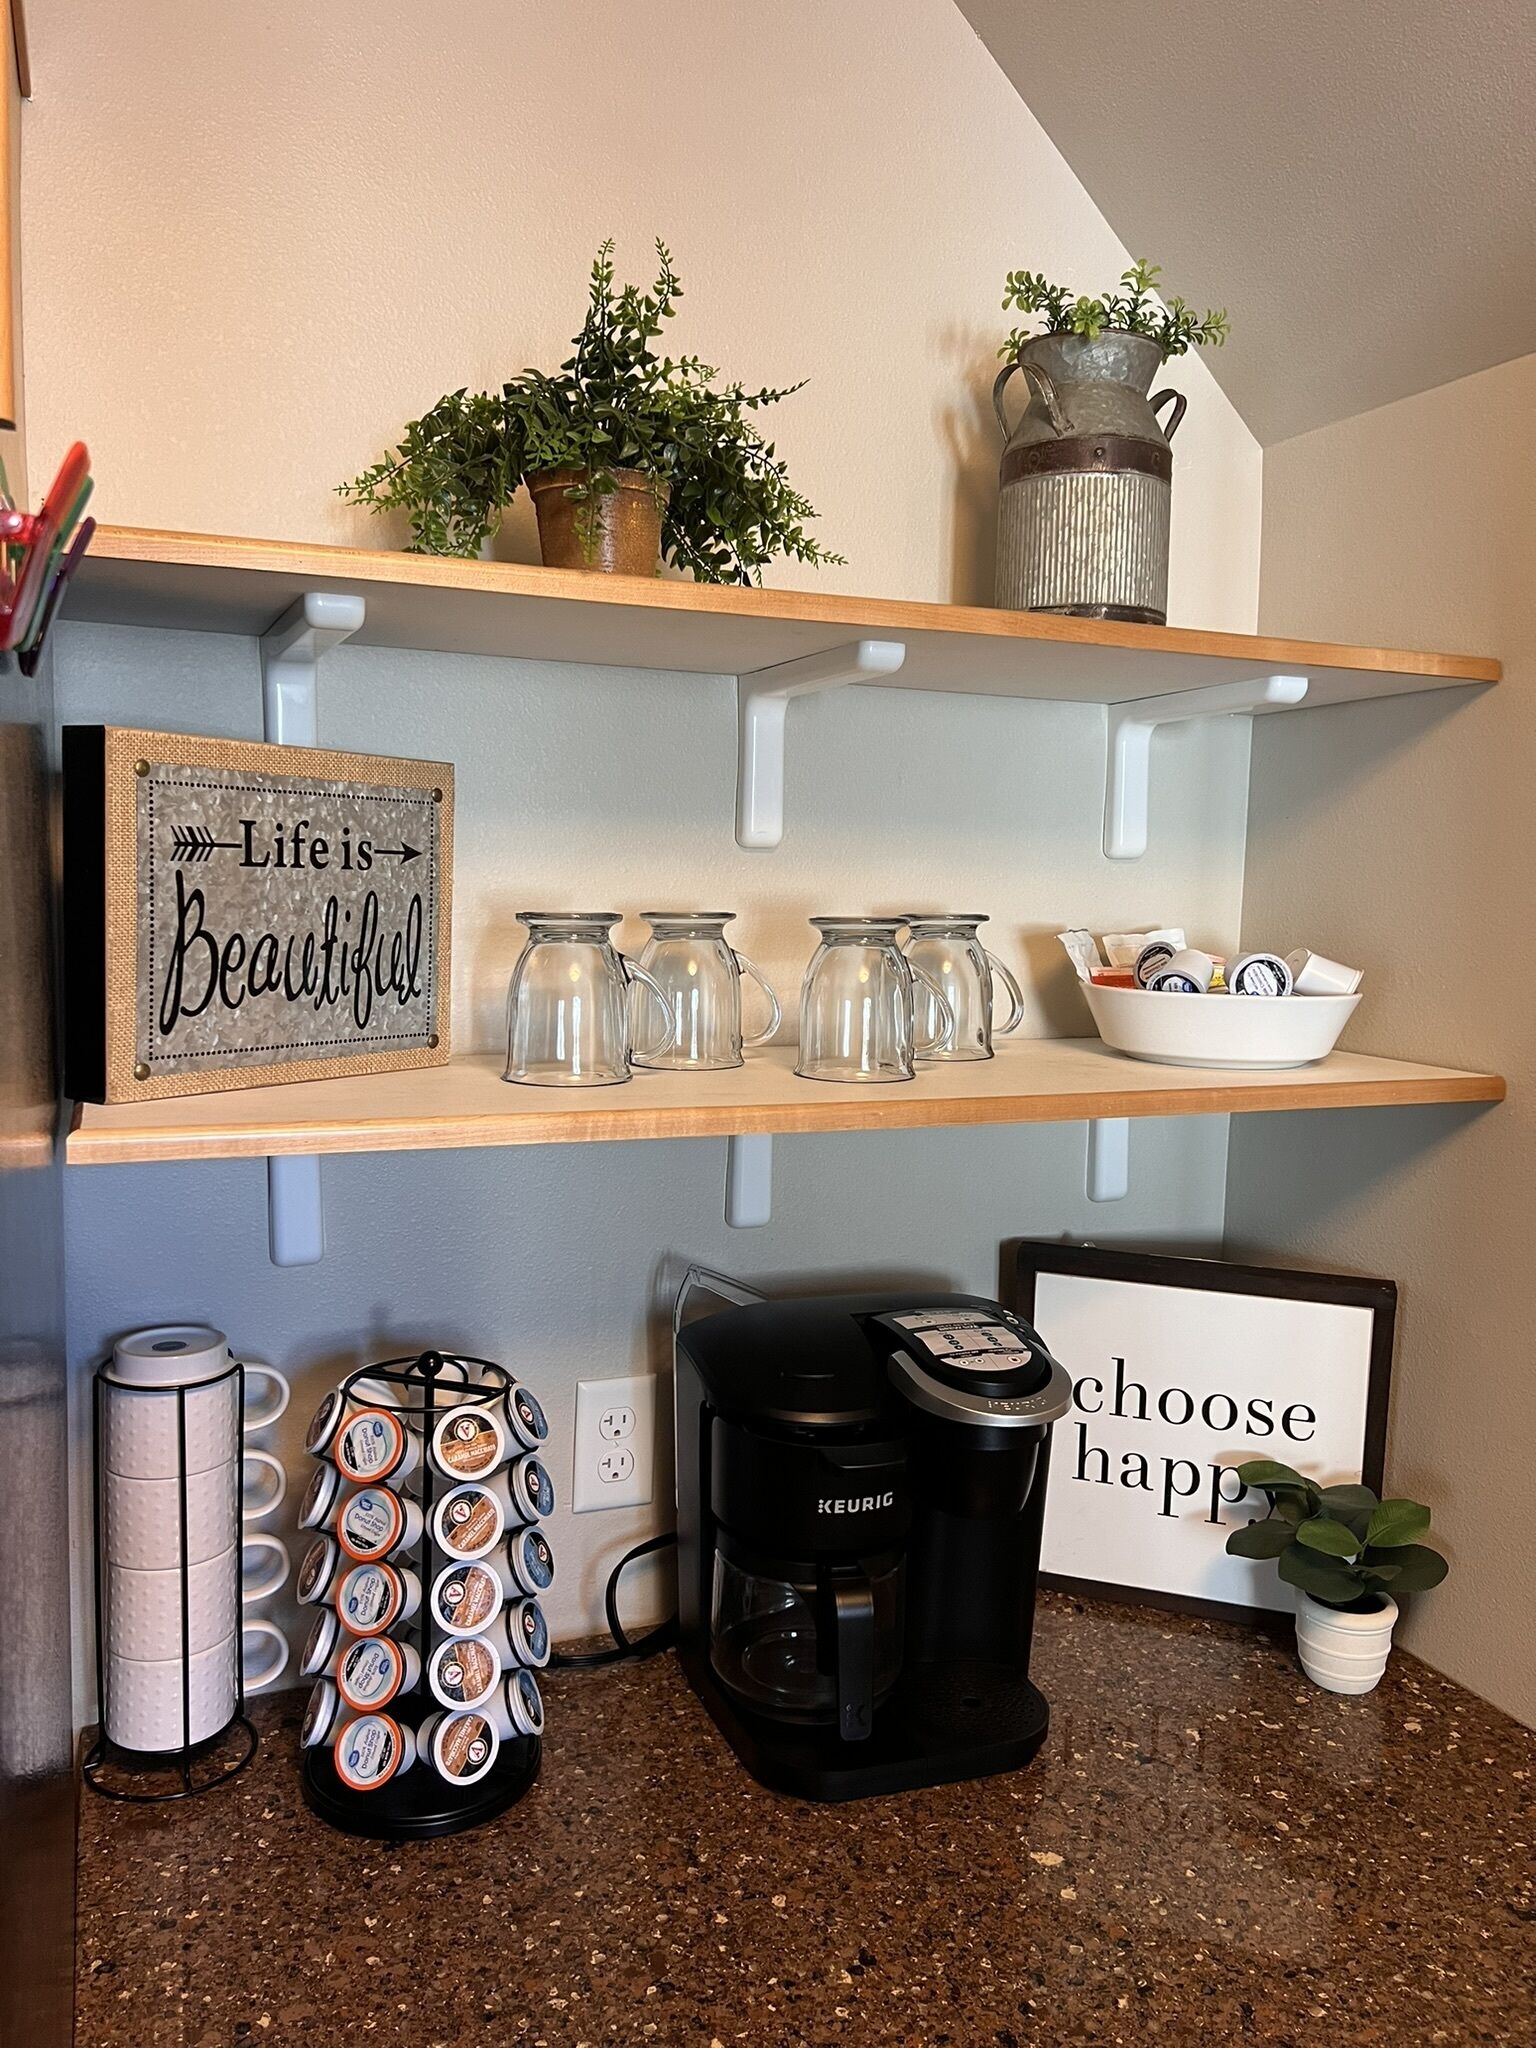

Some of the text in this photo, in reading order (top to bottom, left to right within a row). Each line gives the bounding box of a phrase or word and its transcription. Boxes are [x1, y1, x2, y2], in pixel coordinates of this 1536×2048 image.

[239, 820, 373, 871] Life is
[159, 870, 423, 1035] Beautiful
[1072, 1357, 1316, 1442] choose
[362, 1428, 371, 1447] Donut
[818, 1491, 893, 1513] KEURIG
[355, 1513, 371, 1525] Donut
[361, 1596, 371, 1616] Donut
[366, 1653, 380, 1672] Donut
[362, 1748, 371, 1769] Donut
